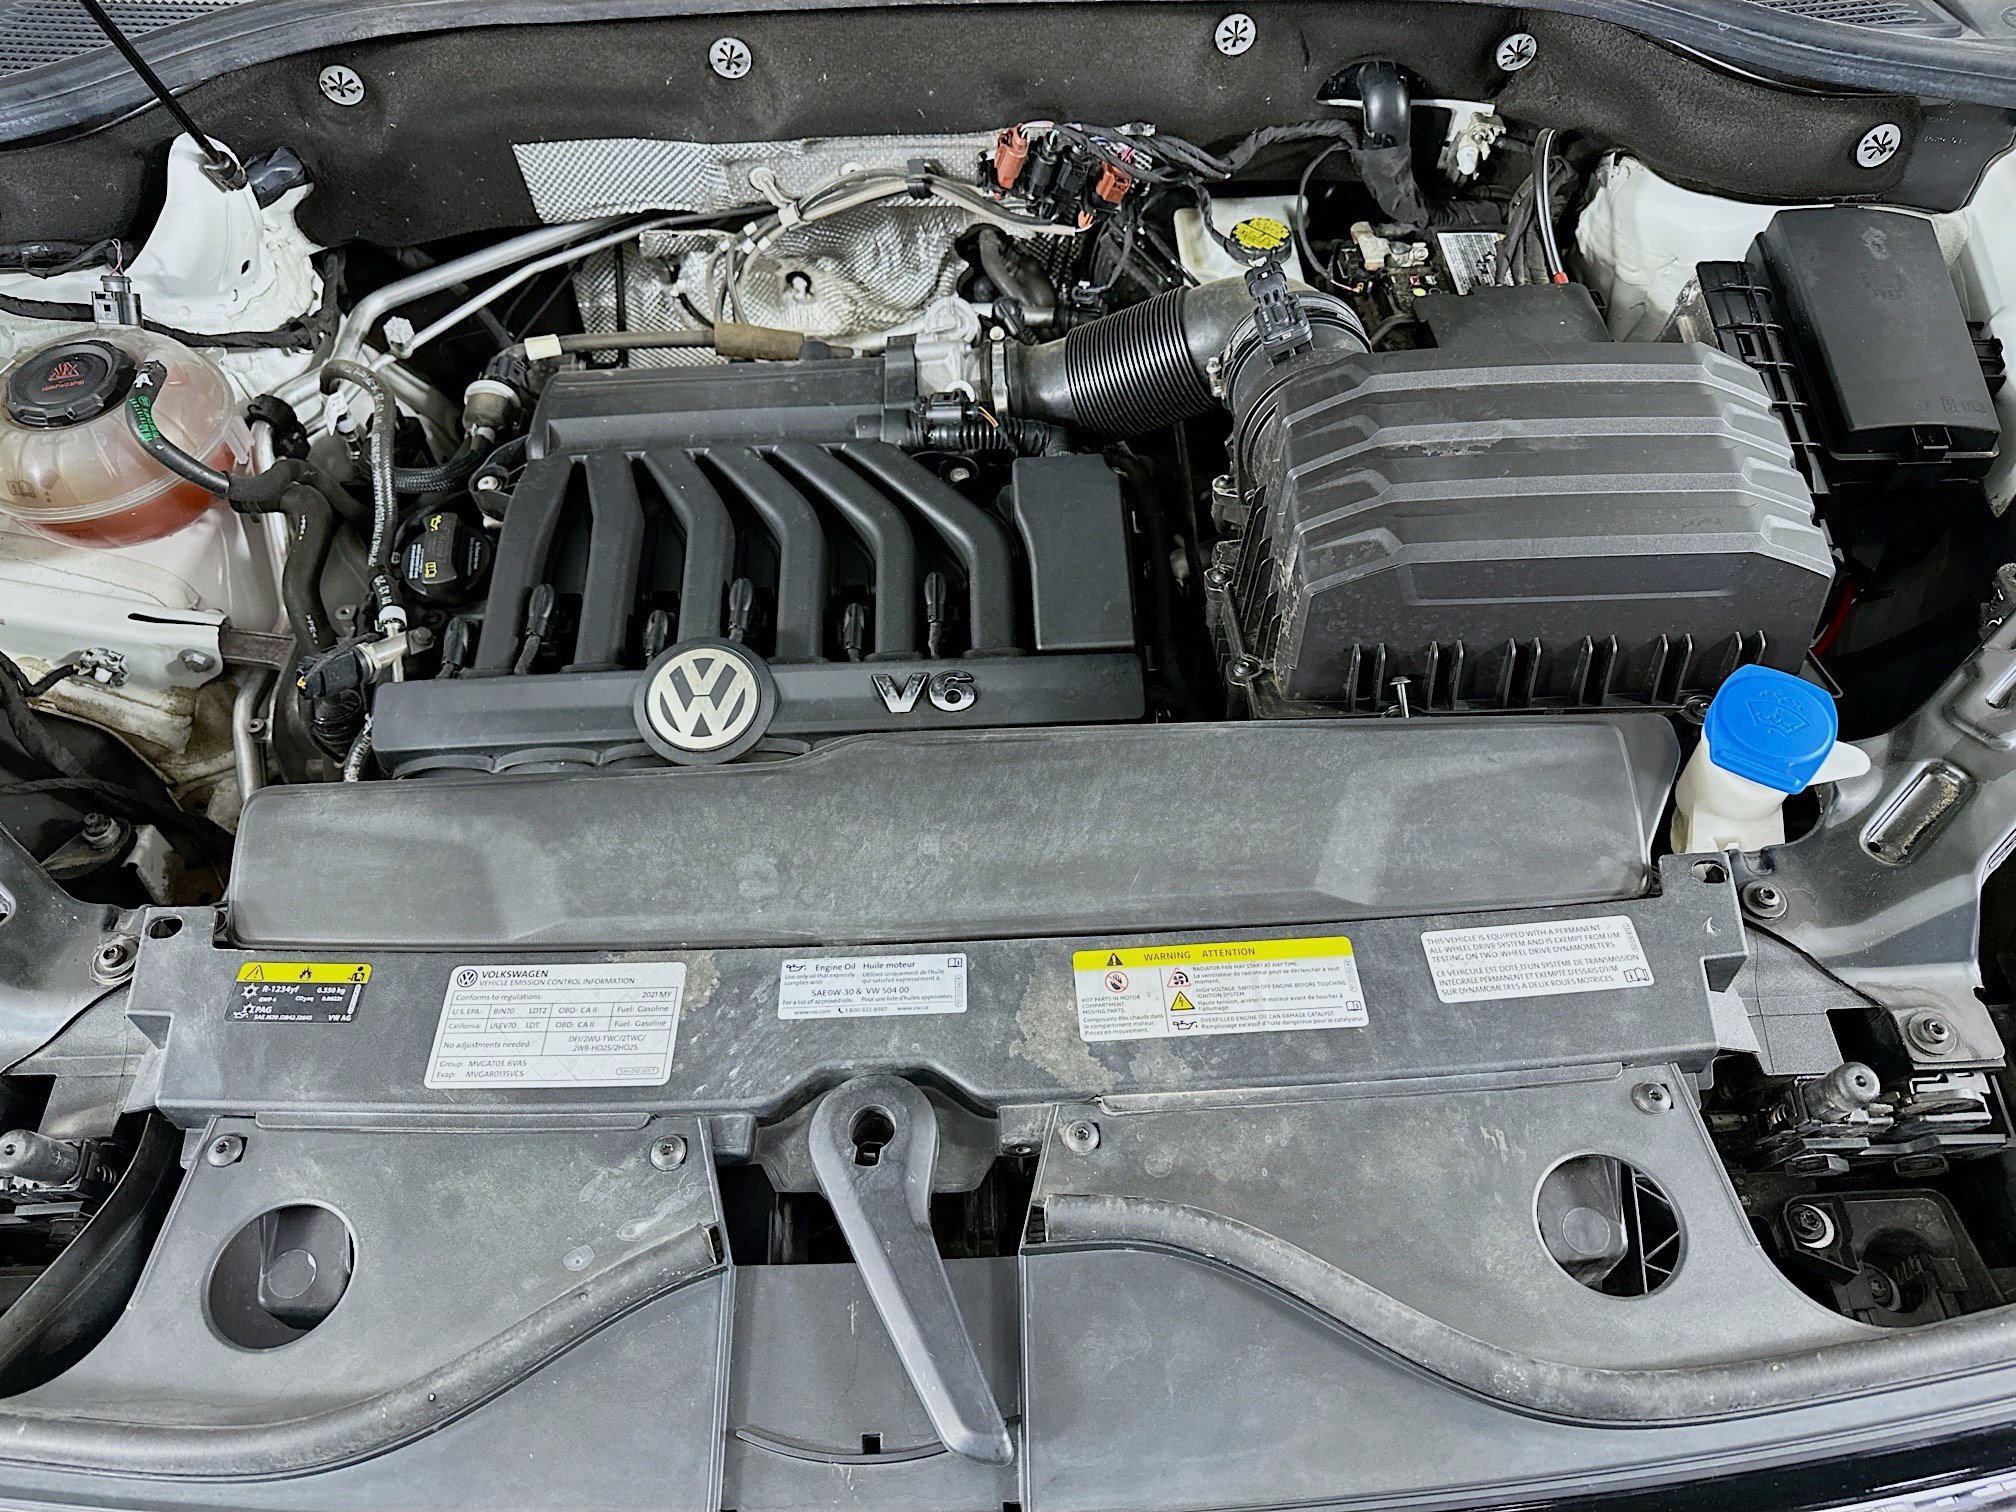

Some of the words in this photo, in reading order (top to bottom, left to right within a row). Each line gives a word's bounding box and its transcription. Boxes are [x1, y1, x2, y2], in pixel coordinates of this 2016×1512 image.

[871, 669, 977, 713] V6
[1444, 934, 1476, 943] VEHICLE
[1486, 930, 1524, 940] EQUIPPED
[1525, 929, 1547, 937] WITH
[1554, 924, 1600, 934] PERMANENT
[1144, 952, 1191, 962] WARNING
[1202, 948, 1256, 958] ATTENTION
[815, 964, 843, 973] Engine
[482, 969, 548, 978] VOLKSWAGEN
[262, 985, 300, 994] R-1234yf
[337, 987, 346, 995] kg
[864, 987, 880, 995] VW
[897, 986, 910, 994] 00
